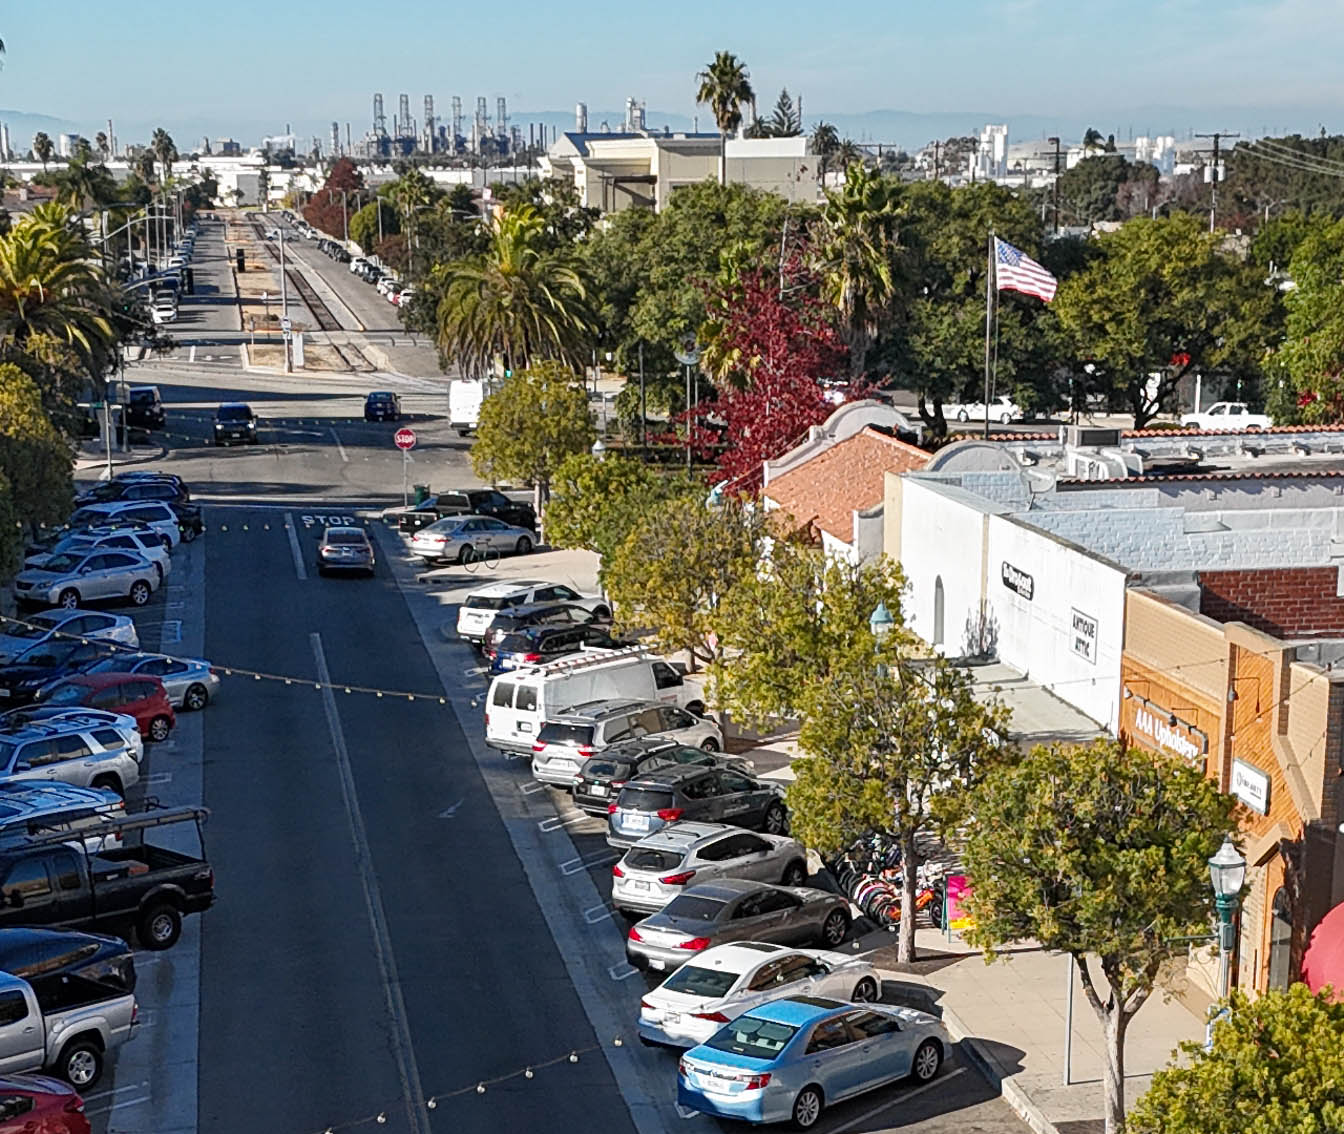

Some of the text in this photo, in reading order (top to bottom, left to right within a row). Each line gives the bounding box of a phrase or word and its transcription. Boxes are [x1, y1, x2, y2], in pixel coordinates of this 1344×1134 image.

[397, 435, 414, 443] STOP
[301, 515, 355, 526] STOP
[1135, 708, 1200, 768] AAA Upholstery
